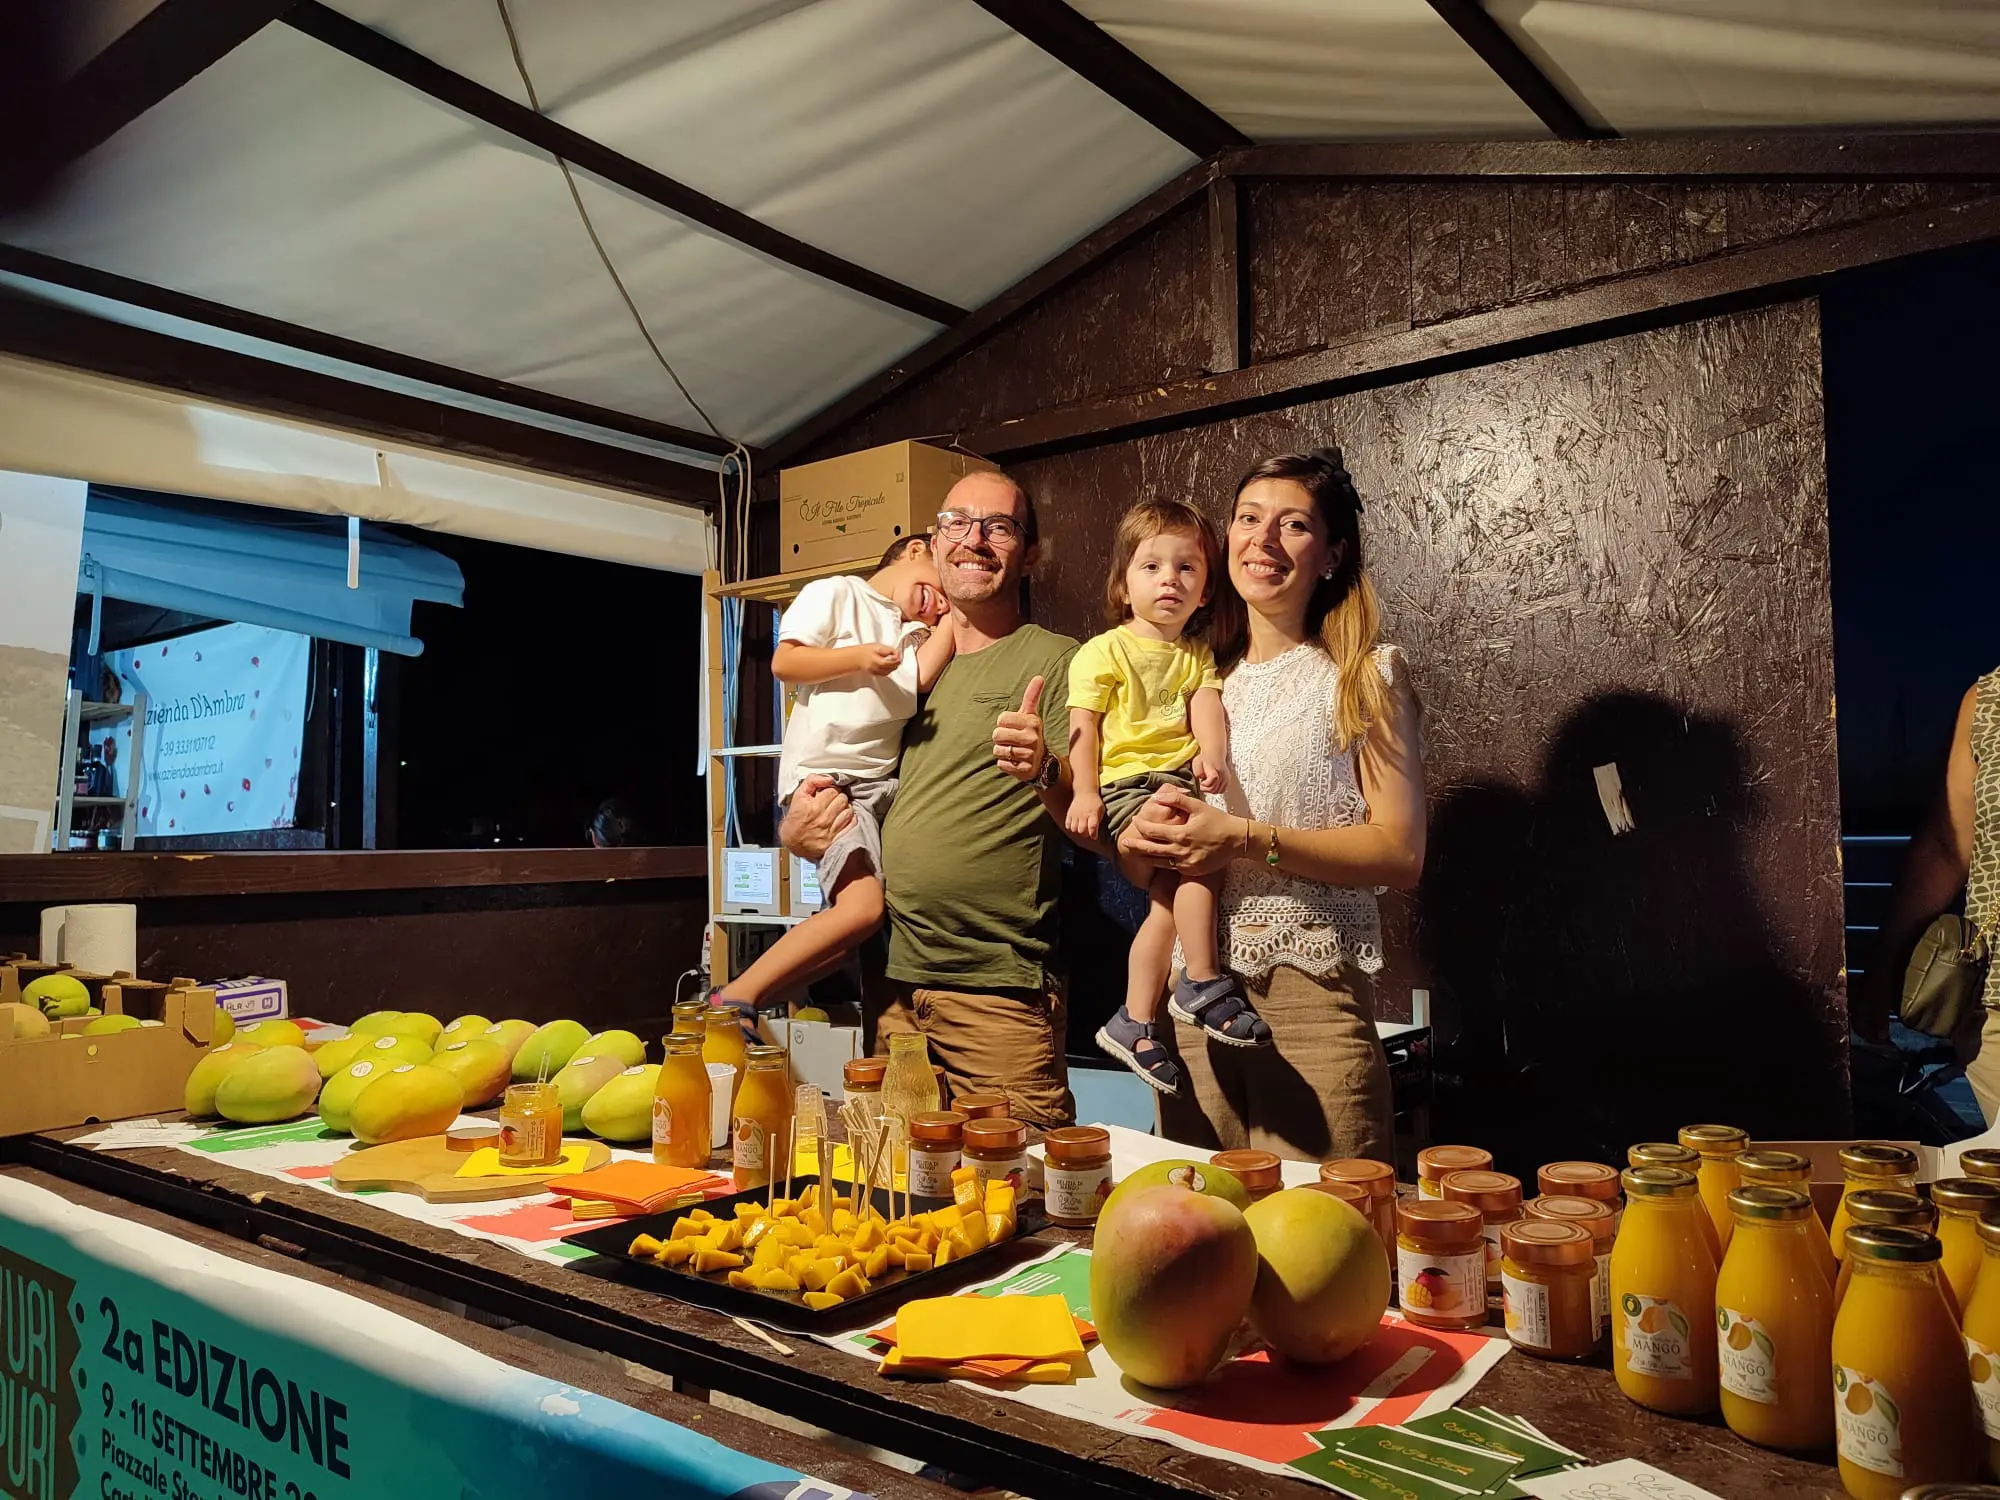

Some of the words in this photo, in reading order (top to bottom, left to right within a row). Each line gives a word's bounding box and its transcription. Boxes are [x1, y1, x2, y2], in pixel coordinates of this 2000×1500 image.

[144, 698, 189, 726] zienda
[190, 689, 246, 719] D'Ambra
[0, 1265, 56, 1393] URI
[1632, 1338, 1681, 1355] MANGO
[100, 1297, 145, 1375] 2a
[152, 1318, 351, 1480] EDIZIONE
[1723, 1353, 1766, 1377] MANGO
[102, 1381, 114, 1418] 9
[131, 1398, 146, 1440] 11
[151, 1408, 278, 1500] SETTEMBRE
[1841, 1418, 1889, 1446] MANGO
[102, 1427, 168, 1496] Piazzale
